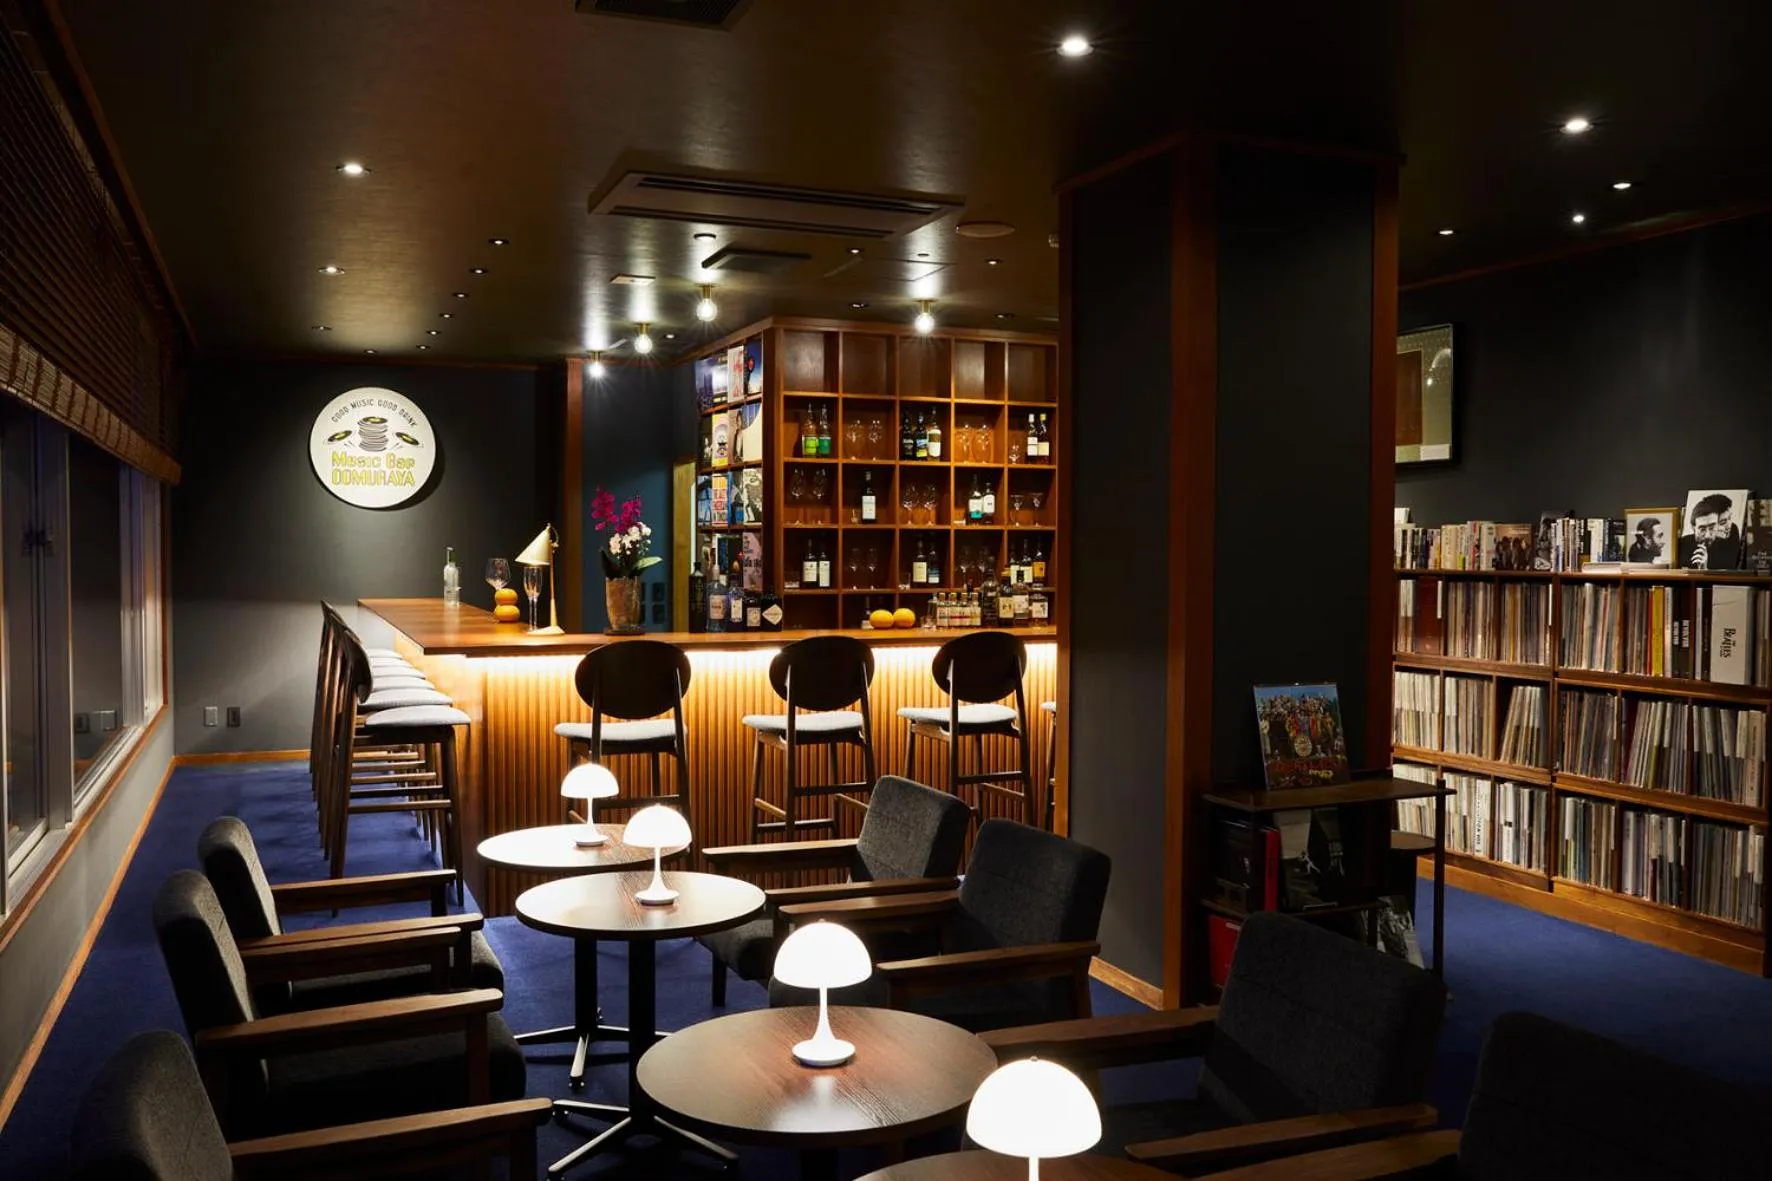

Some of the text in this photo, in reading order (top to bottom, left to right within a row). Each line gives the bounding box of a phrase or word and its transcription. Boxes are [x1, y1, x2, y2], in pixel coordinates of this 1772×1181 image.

[331, 399, 418, 427] GOOD MUSIC GOOD DRINK
[332, 451, 416, 469] Music Bar
